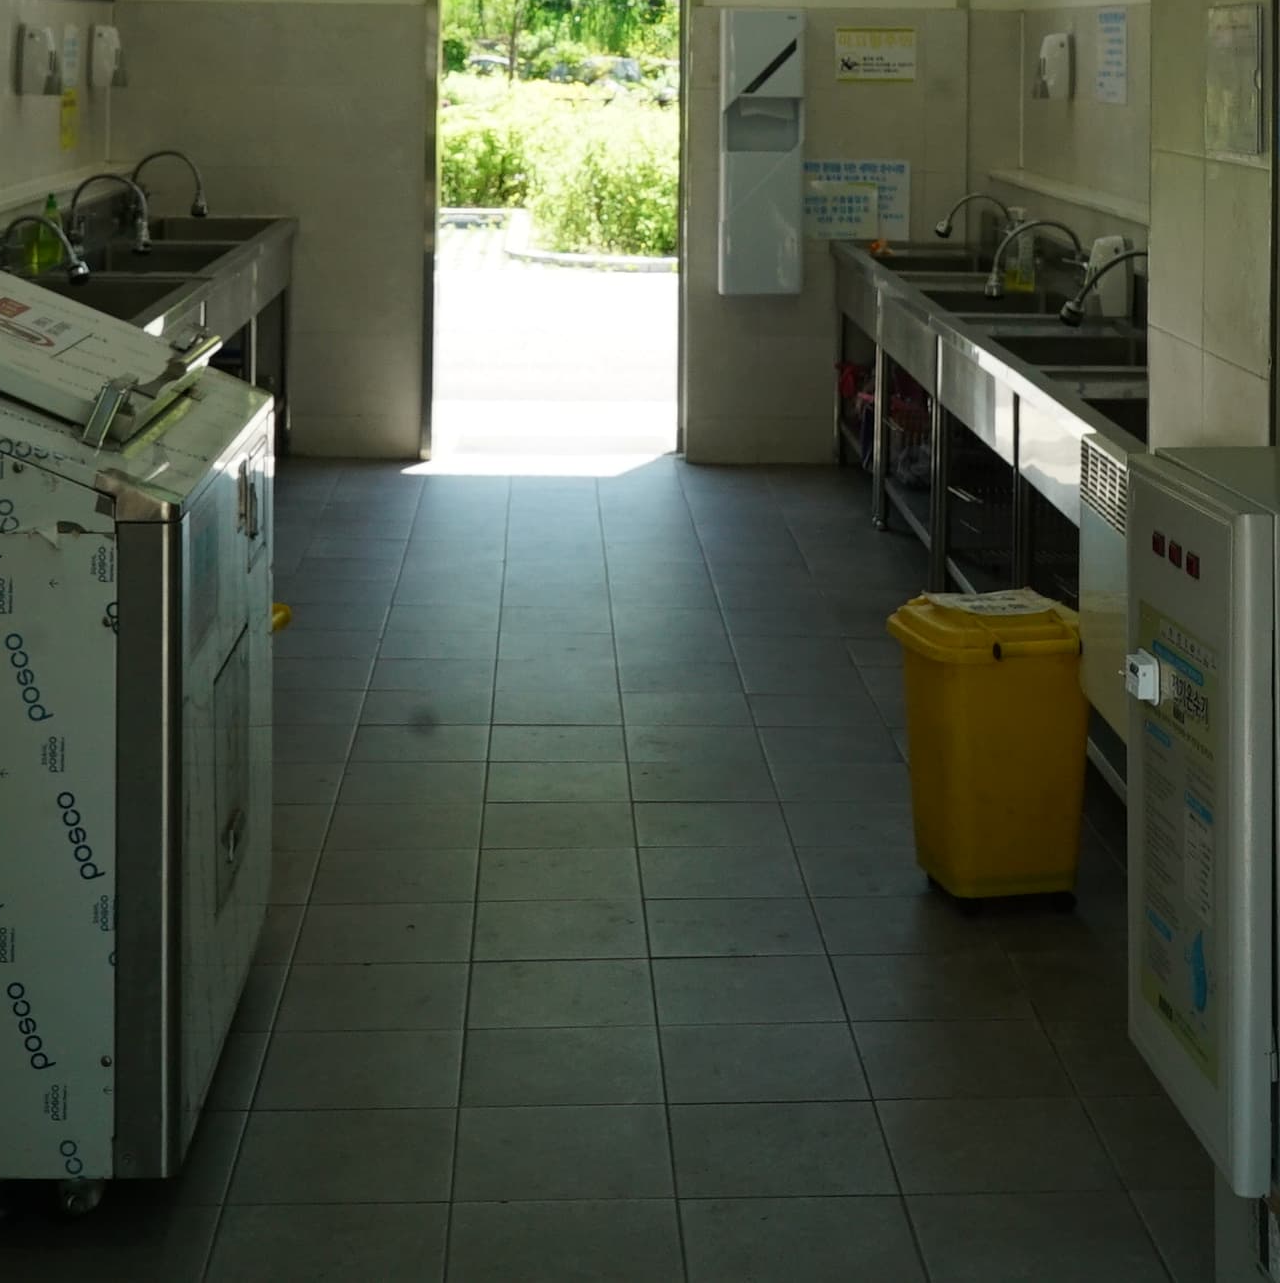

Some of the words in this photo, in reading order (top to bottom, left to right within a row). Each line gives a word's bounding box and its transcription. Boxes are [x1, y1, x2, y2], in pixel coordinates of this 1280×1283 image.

[5, 633, 54, 722] posco
[57, 791, 106, 880] posco
[7, 982, 57, 1070] posco
